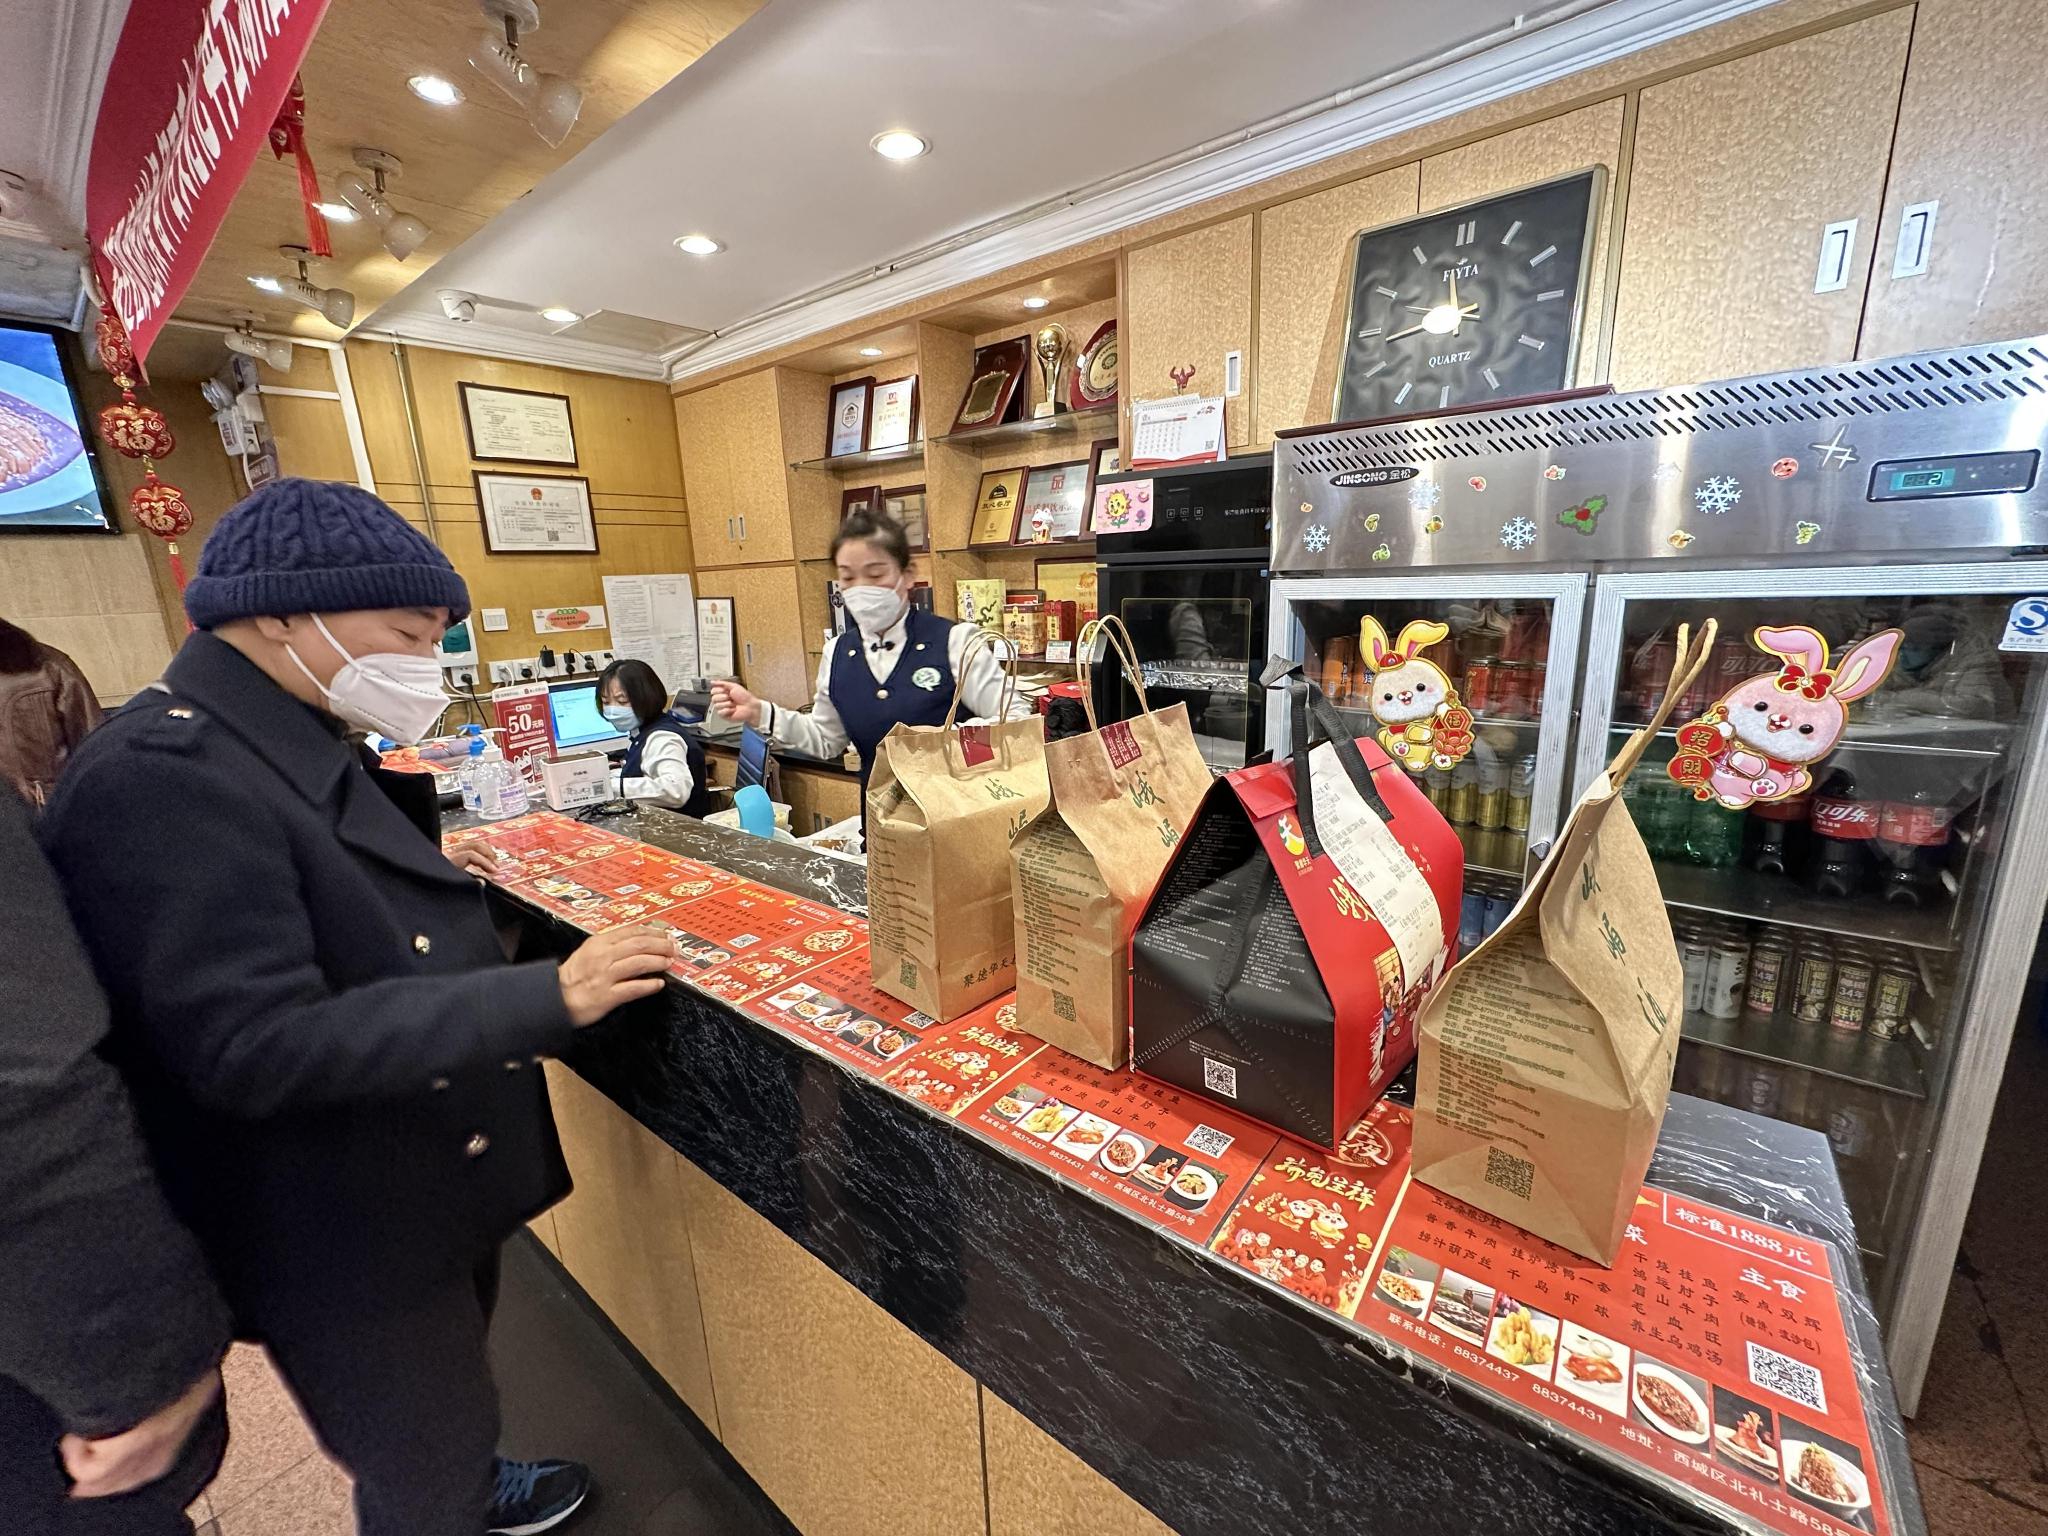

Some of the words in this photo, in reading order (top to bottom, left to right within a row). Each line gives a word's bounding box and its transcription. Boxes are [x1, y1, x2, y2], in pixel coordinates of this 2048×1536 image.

[1428, 350, 1471, 368] QUARTZ
[1334, 470, 1388, 486] JINSONG
[1389, 468, 1411, 481] 金松
[1447, 713, 1466, 727] 福
[1690, 730, 1714, 747] 招
[1681, 760, 1702, 775] 財
[1814, 798, 1869, 822] 口可乐
[1675, 1207, 1813, 1266] 标准1888元
[1632, 1267, 1720, 1307] 鸿运肘子
[1633, 1251, 1719, 1292] 干烧桂鱼
[1739, 1267, 1807, 1304] 主食
[1507, 1268, 1610, 1318] 千岛虾球
[1632, 1283, 1720, 1327] 眉山牛肉
[1630, 1318, 1723, 1366] 养生乌鸡汤
[1631, 1300, 1722, 1348] 毛血旺
[1453, 1344, 1520, 1383] 88374437
[1532, 1382, 1604, 1425] 88374431
